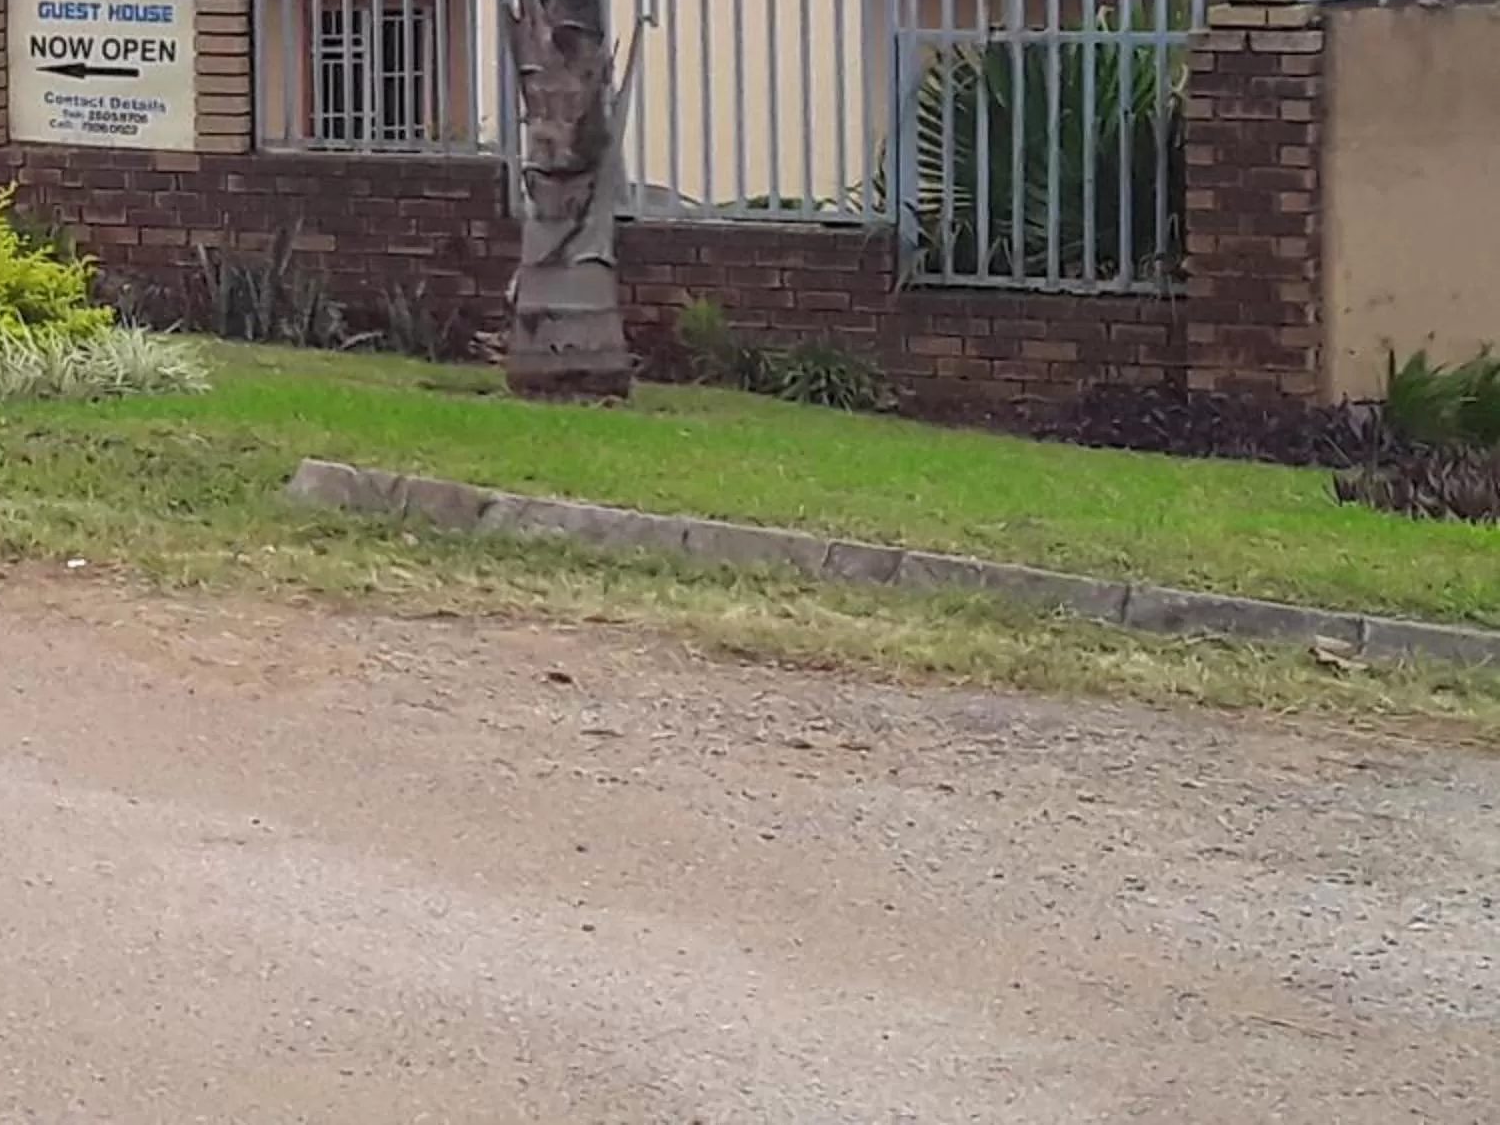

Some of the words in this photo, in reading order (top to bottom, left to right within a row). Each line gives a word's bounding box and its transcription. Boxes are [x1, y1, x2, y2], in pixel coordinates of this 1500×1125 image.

[38, 1, 101, 21] GUEST
[108, 3, 173, 23] HOUSE
[30, 35, 94, 60] NOW
[101, 38, 176, 63] OPEN
[43, 91, 104, 108] Contact
[110, 96, 167, 113] Details
